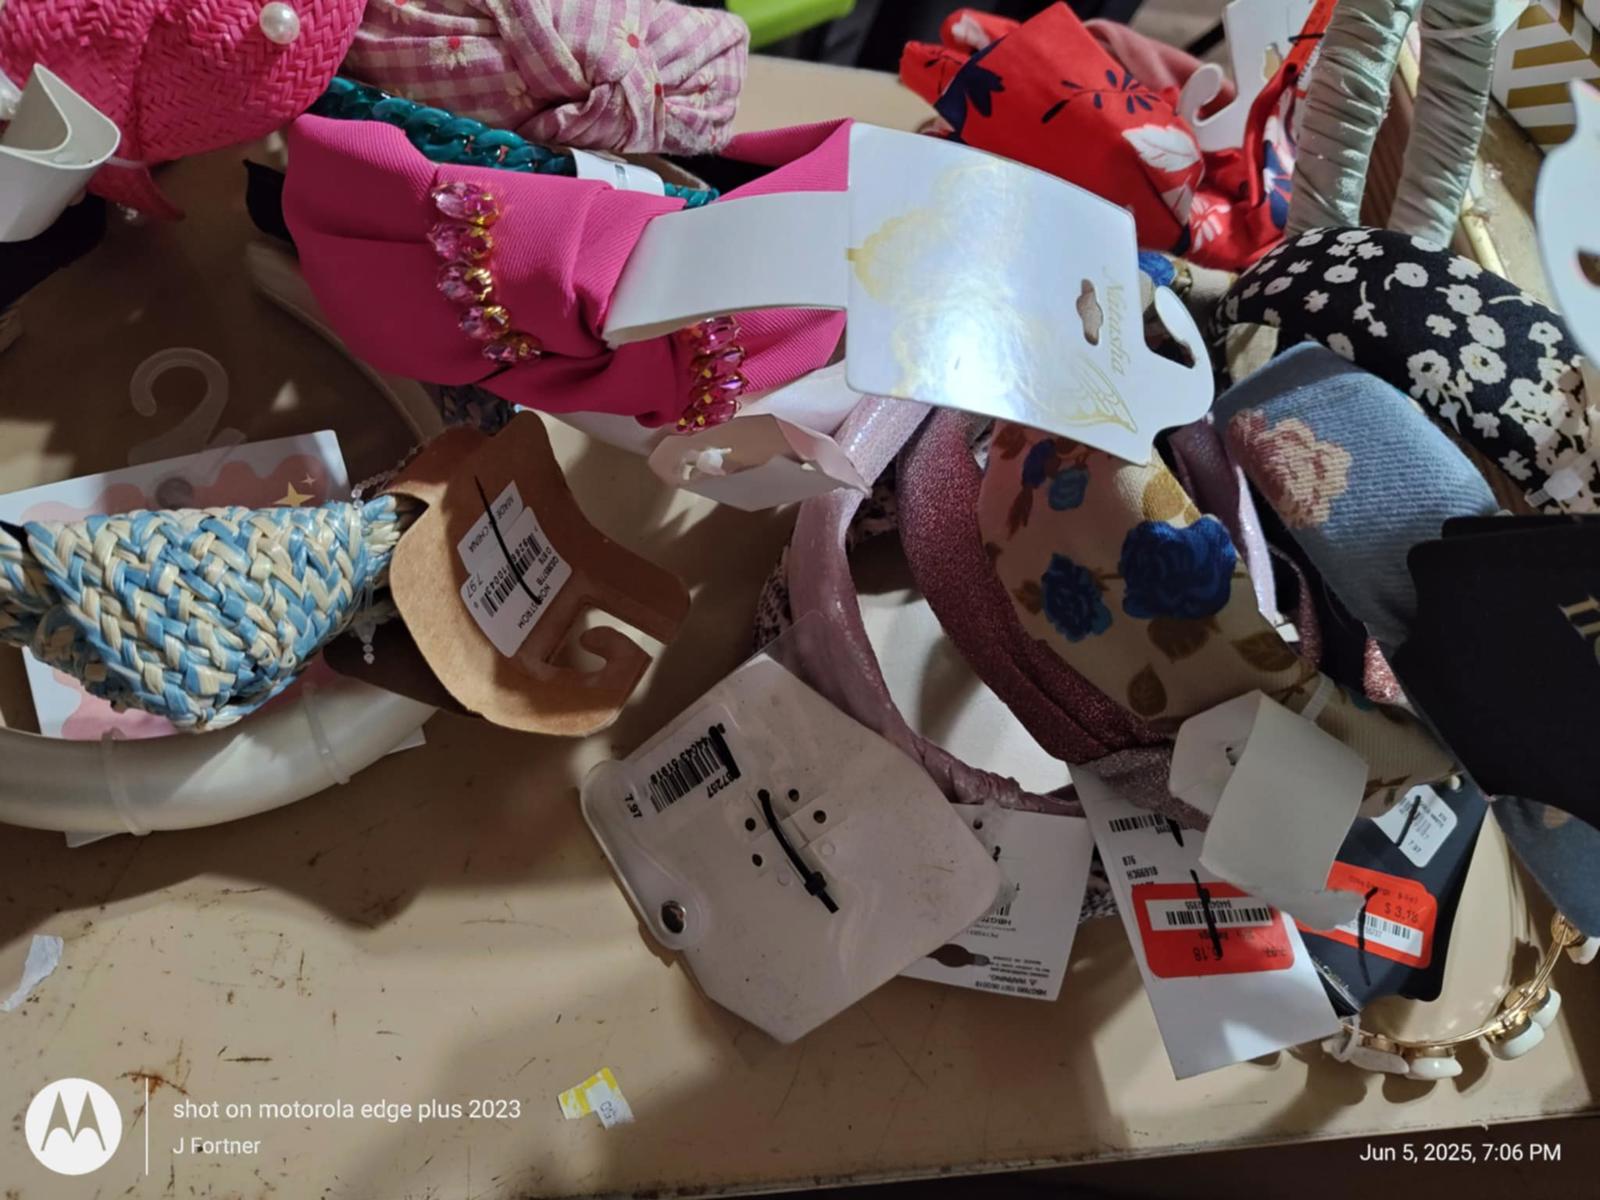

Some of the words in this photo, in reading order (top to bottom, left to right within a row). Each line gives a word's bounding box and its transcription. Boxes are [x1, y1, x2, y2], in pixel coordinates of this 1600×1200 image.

[468, 526, 489, 553] CHINA
[466, 572, 483, 599] 7.97
[518, 584, 551, 629] NORSTROM
